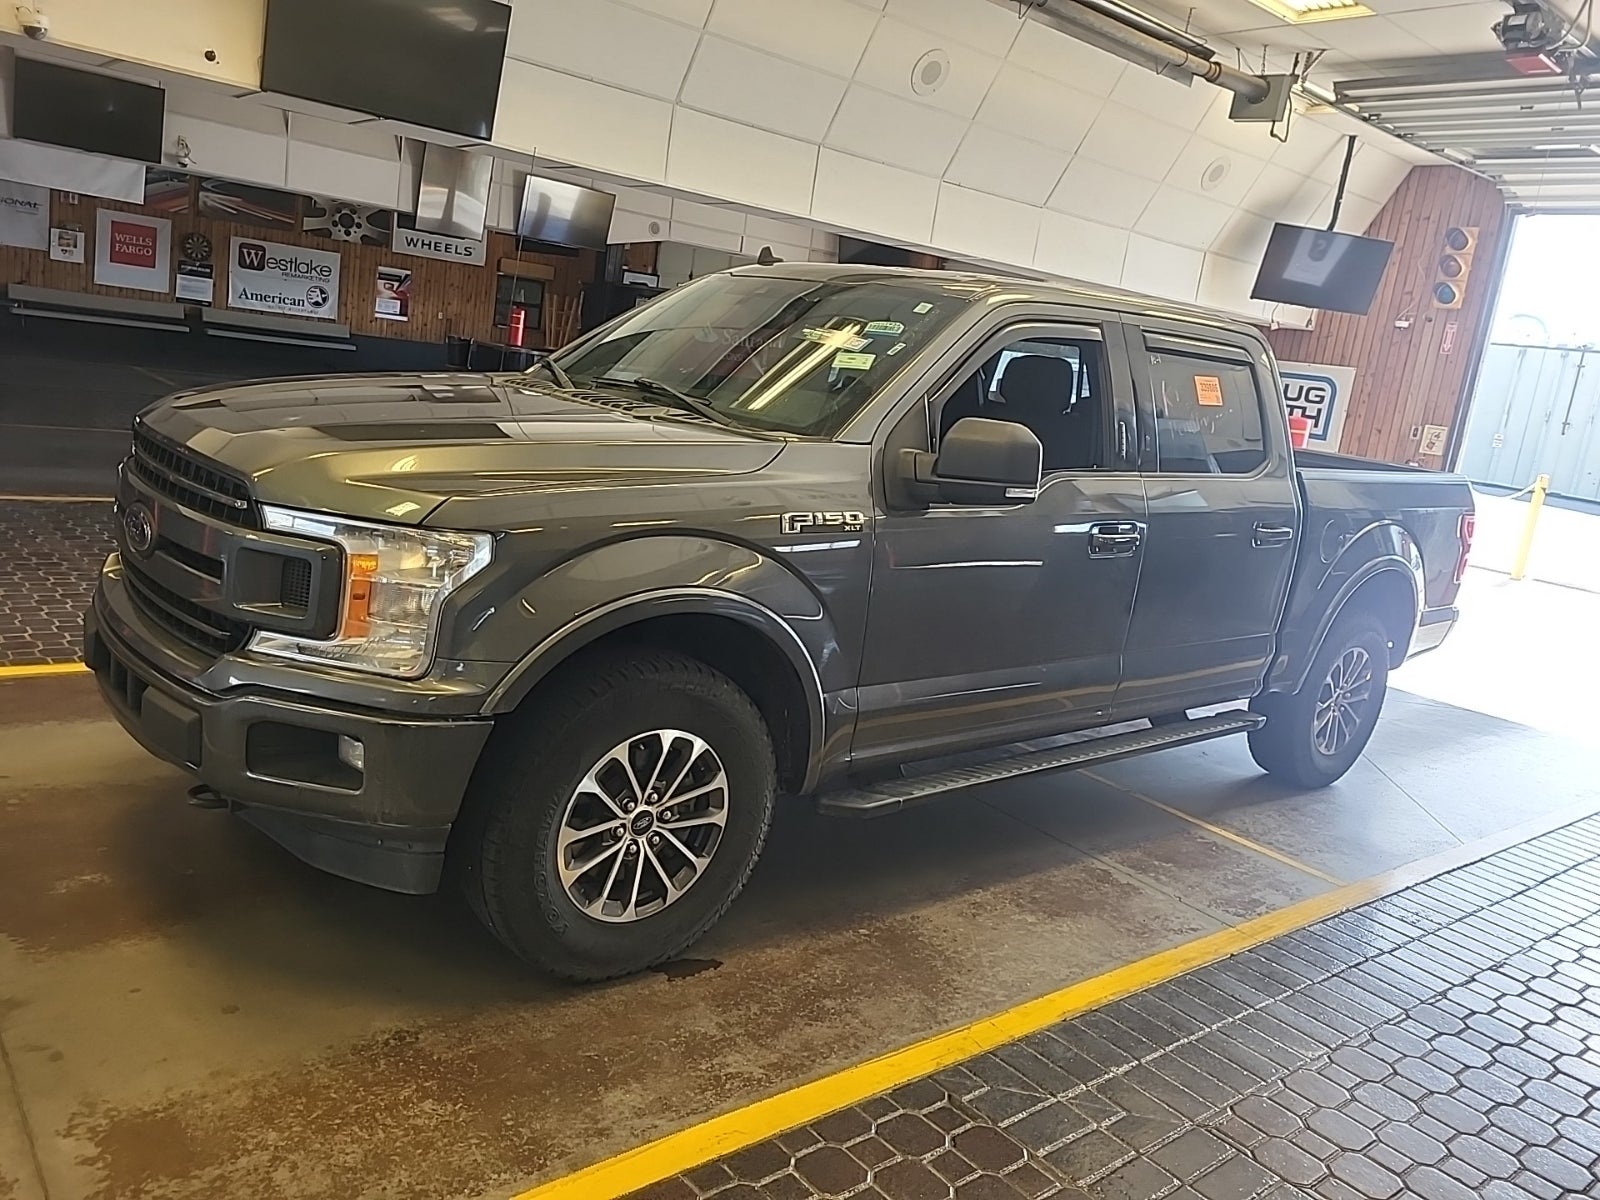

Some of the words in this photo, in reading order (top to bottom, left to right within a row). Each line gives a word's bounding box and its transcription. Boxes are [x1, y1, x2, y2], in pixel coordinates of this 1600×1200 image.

[115, 233, 152, 246] WELLS
[405, 236, 473, 257] WHEELS
[115, 244, 152, 256] FARGO
[240, 246, 332, 277] Westlake
[282, 272, 330, 283] REMARKETING
[238, 287, 305, 307] American
